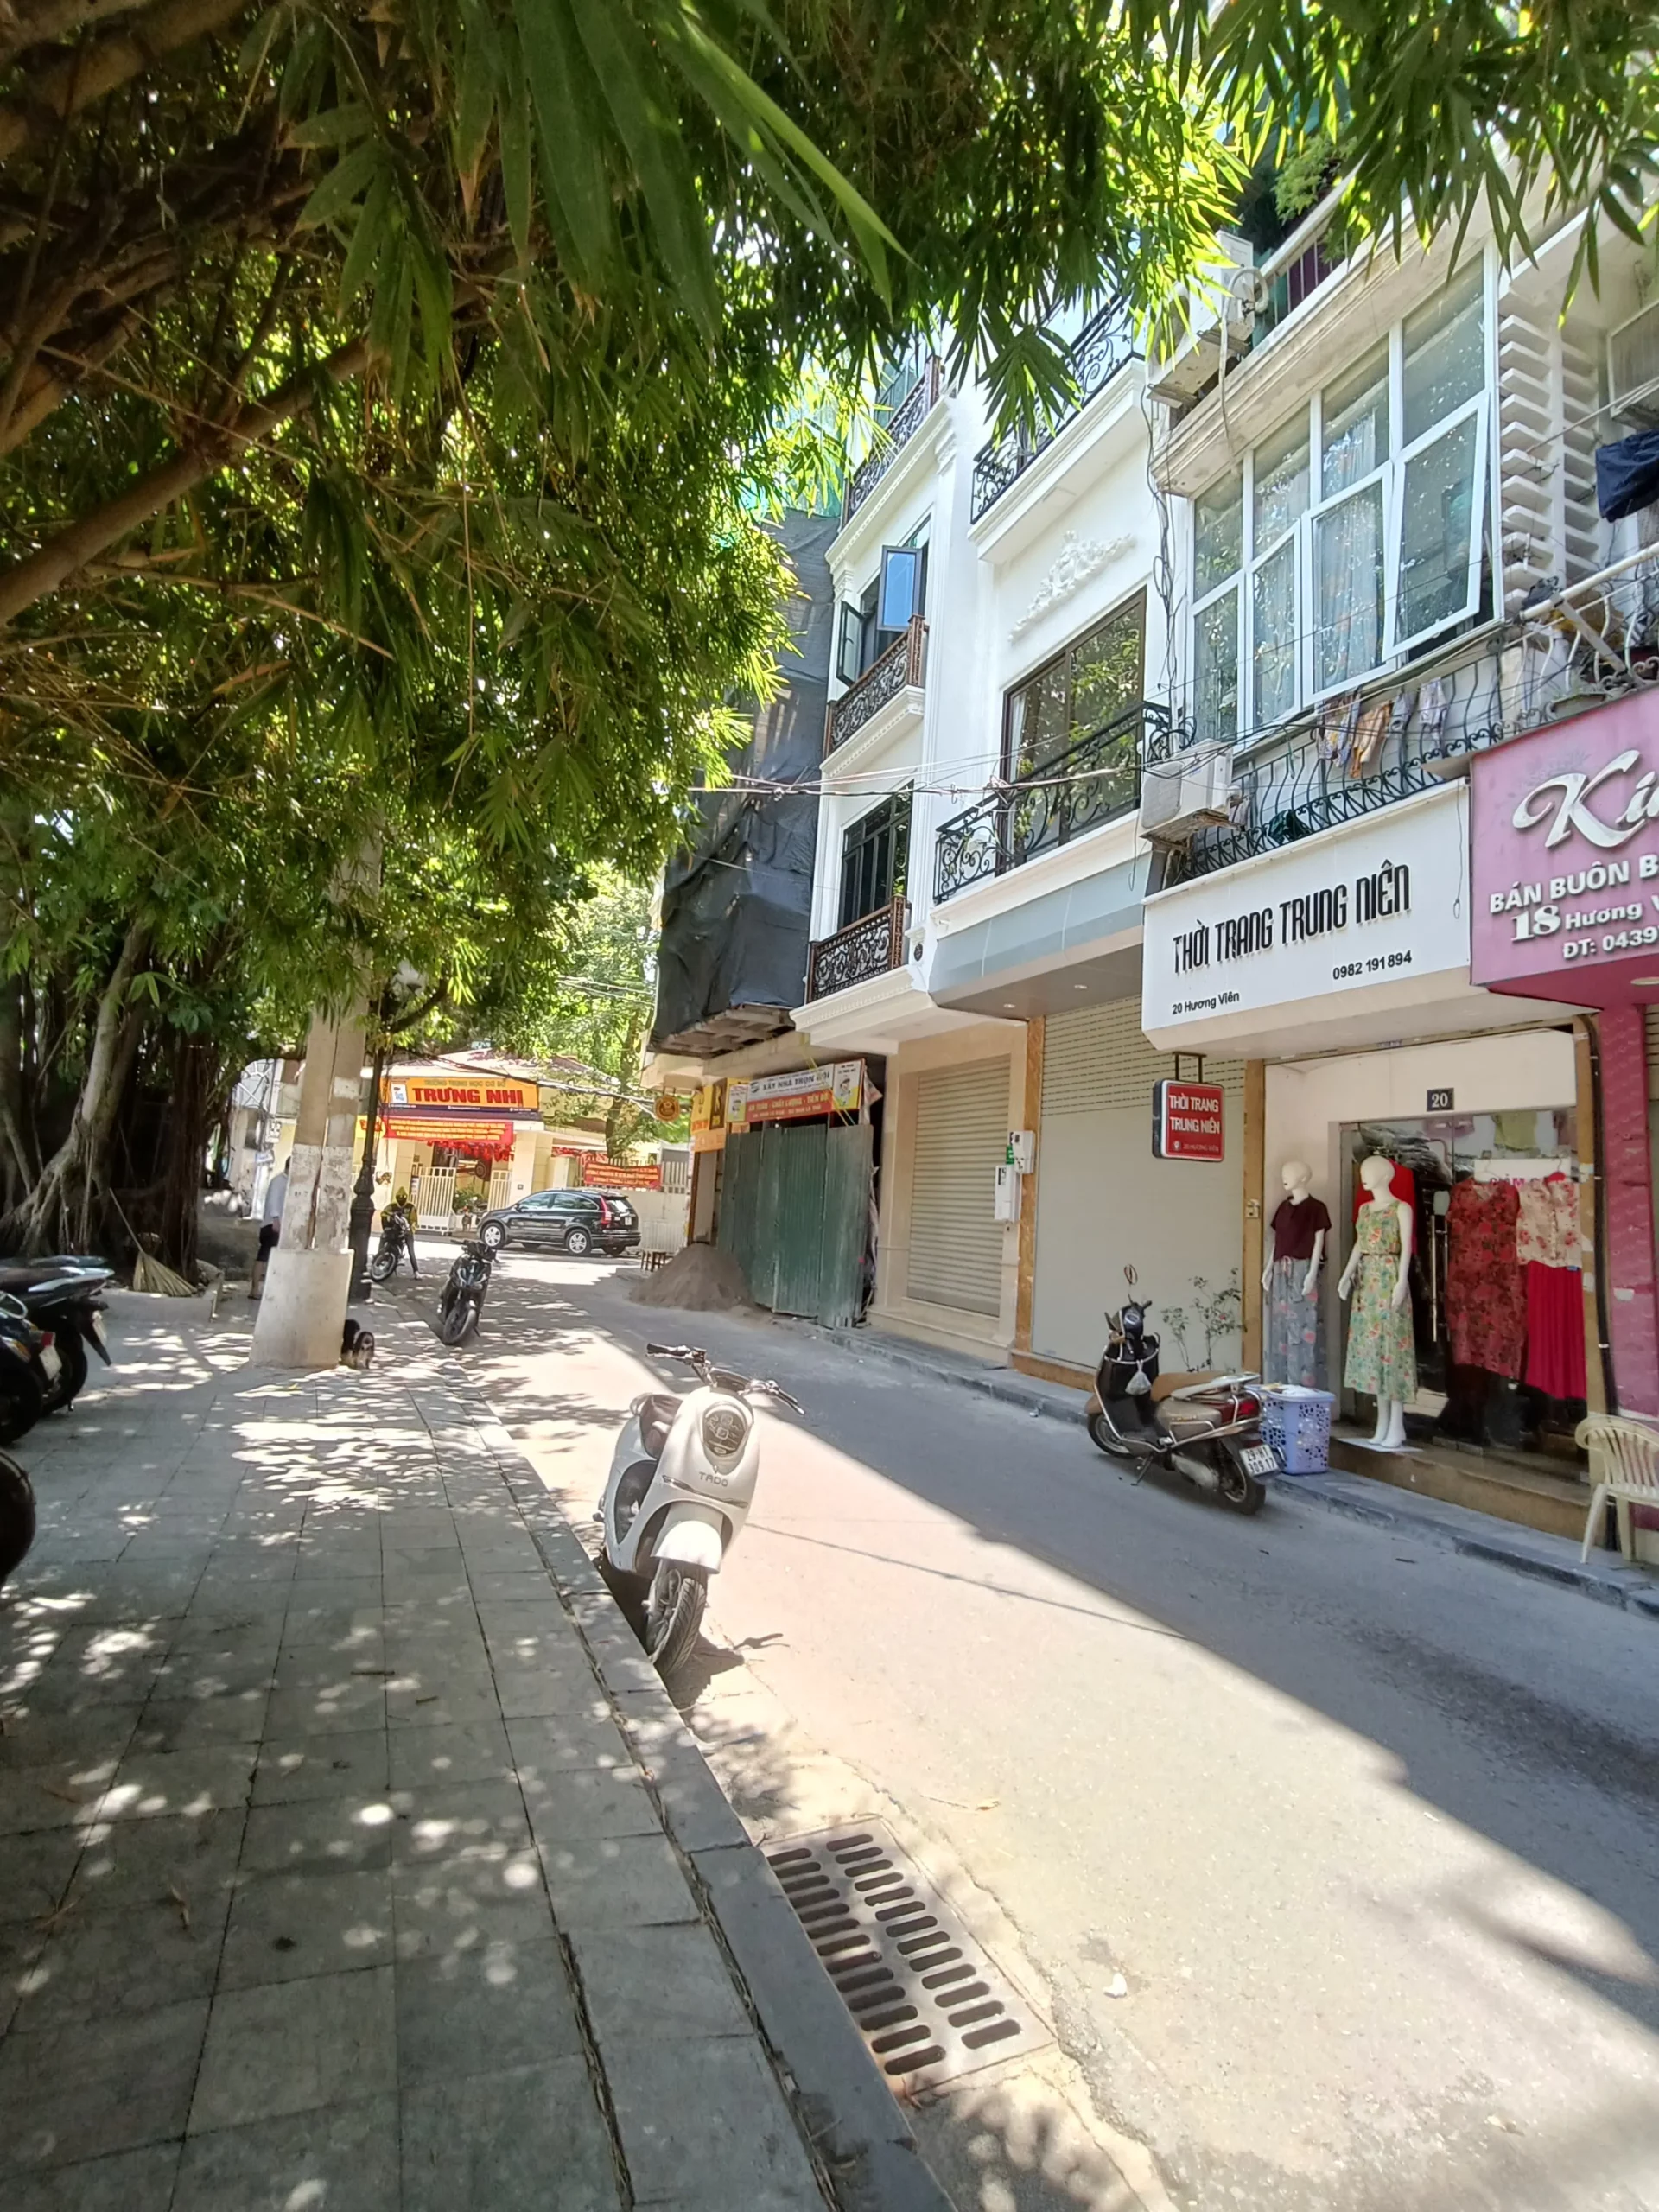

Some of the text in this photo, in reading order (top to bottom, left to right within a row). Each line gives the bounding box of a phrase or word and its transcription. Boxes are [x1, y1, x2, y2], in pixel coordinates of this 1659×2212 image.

[1490, 854, 1659, 913] BÁN BUÔN B
[1173, 859, 1410, 974] THỜI TRANG TRUNG NIÊN
[1511, 903, 1643, 942] 18 Hương
[1562, 925, 1659, 959] ĐT: 0439
[1332, 962, 1363, 980] 0982
[1172, 991, 1240, 1015] 20 Hương Viên
[412, 1086, 524, 1107] TRƯNG NHỊ
[1169, 1092, 1219, 1113] THỜI TRANG
[1431, 1092, 1449, 1108] 20
[1170, 1116, 1220, 1135] TRUNG NIÊN
